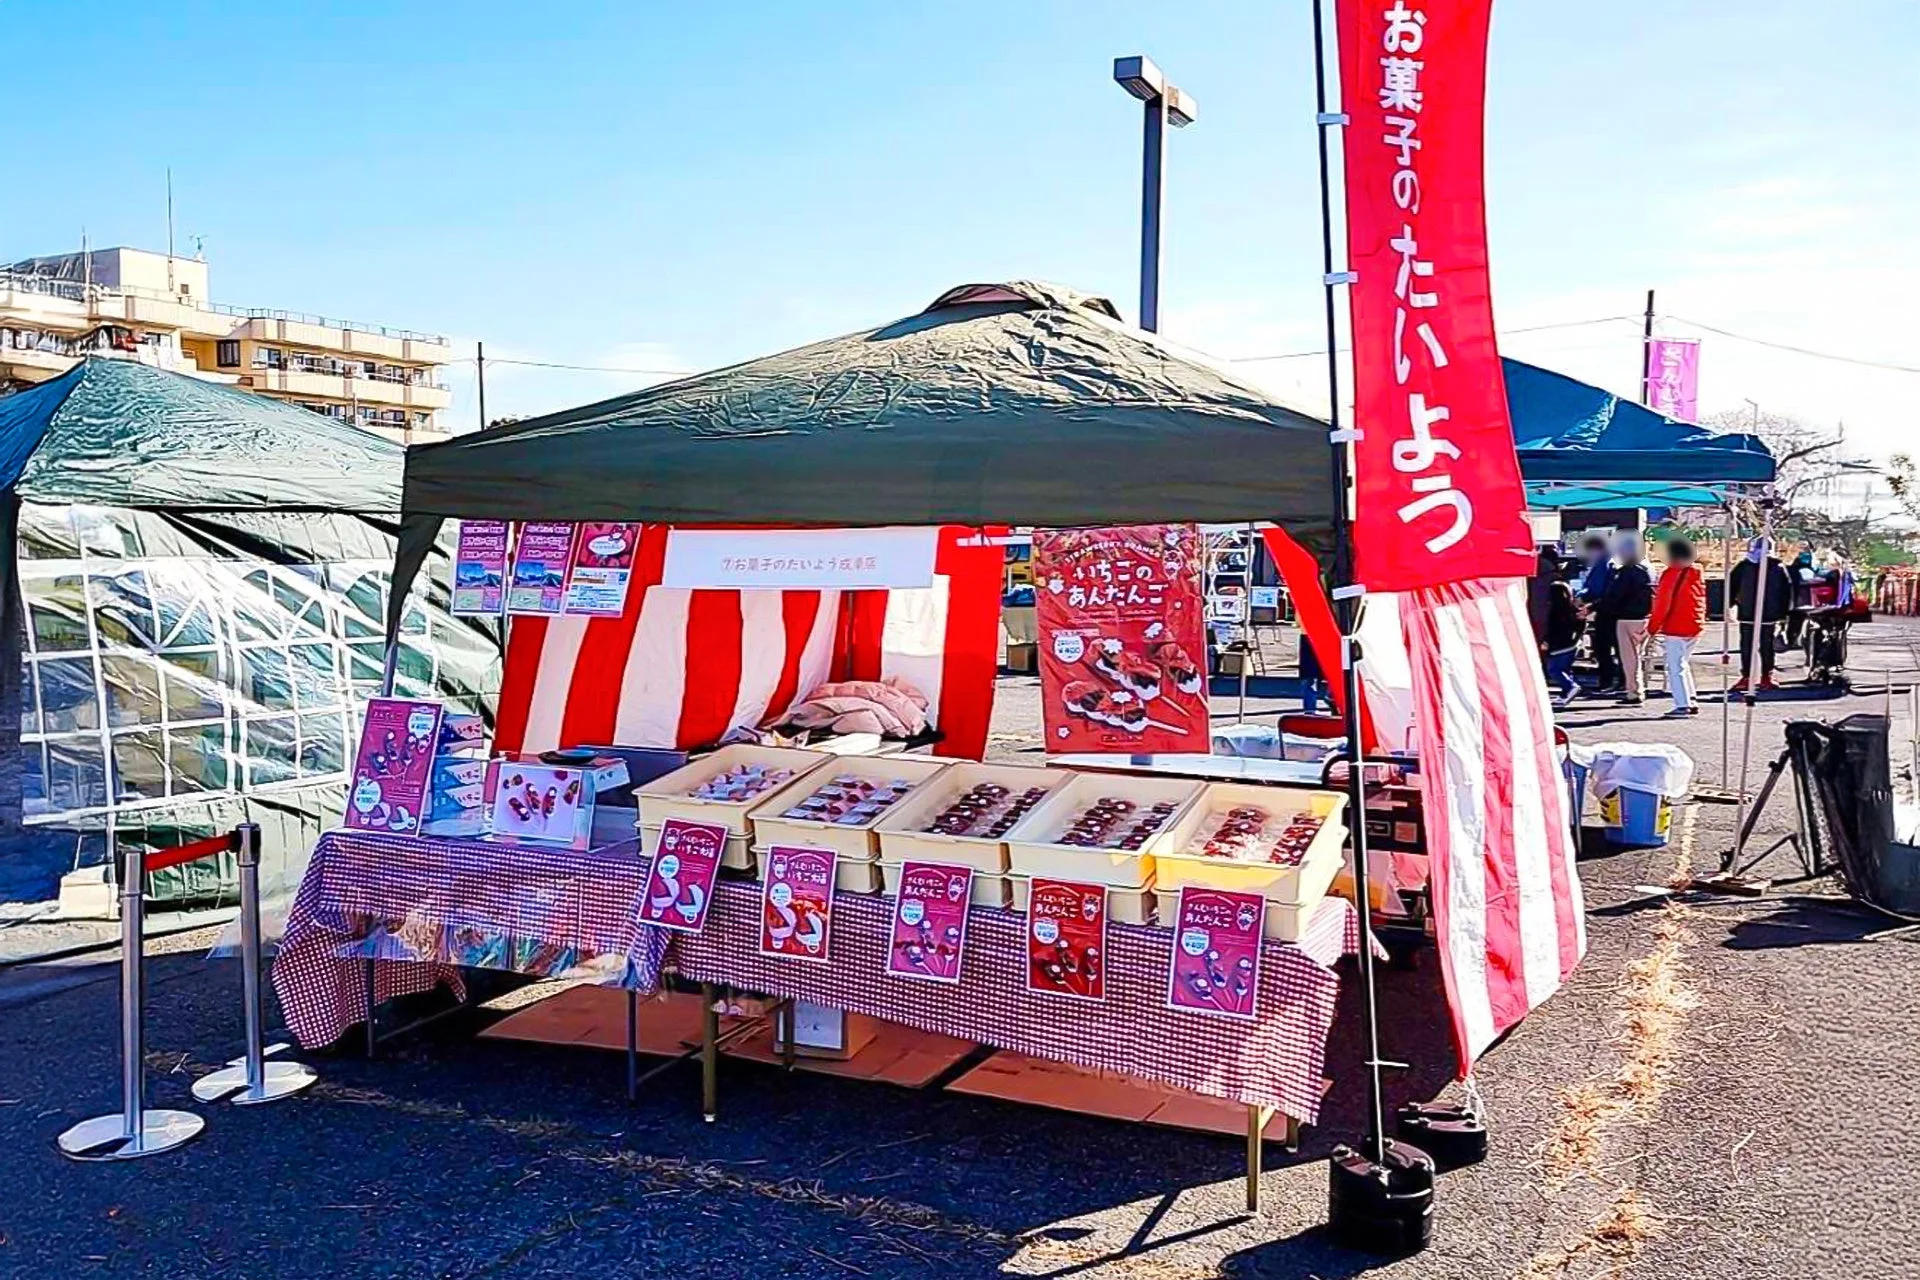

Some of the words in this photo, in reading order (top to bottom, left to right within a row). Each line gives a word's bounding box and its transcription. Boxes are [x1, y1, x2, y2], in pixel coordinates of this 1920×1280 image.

[1379, 0, 1474, 554] お菓子のたいよう
[1073, 559, 1153, 583] いちごの
[1068, 584, 1168, 609] あんだんご
